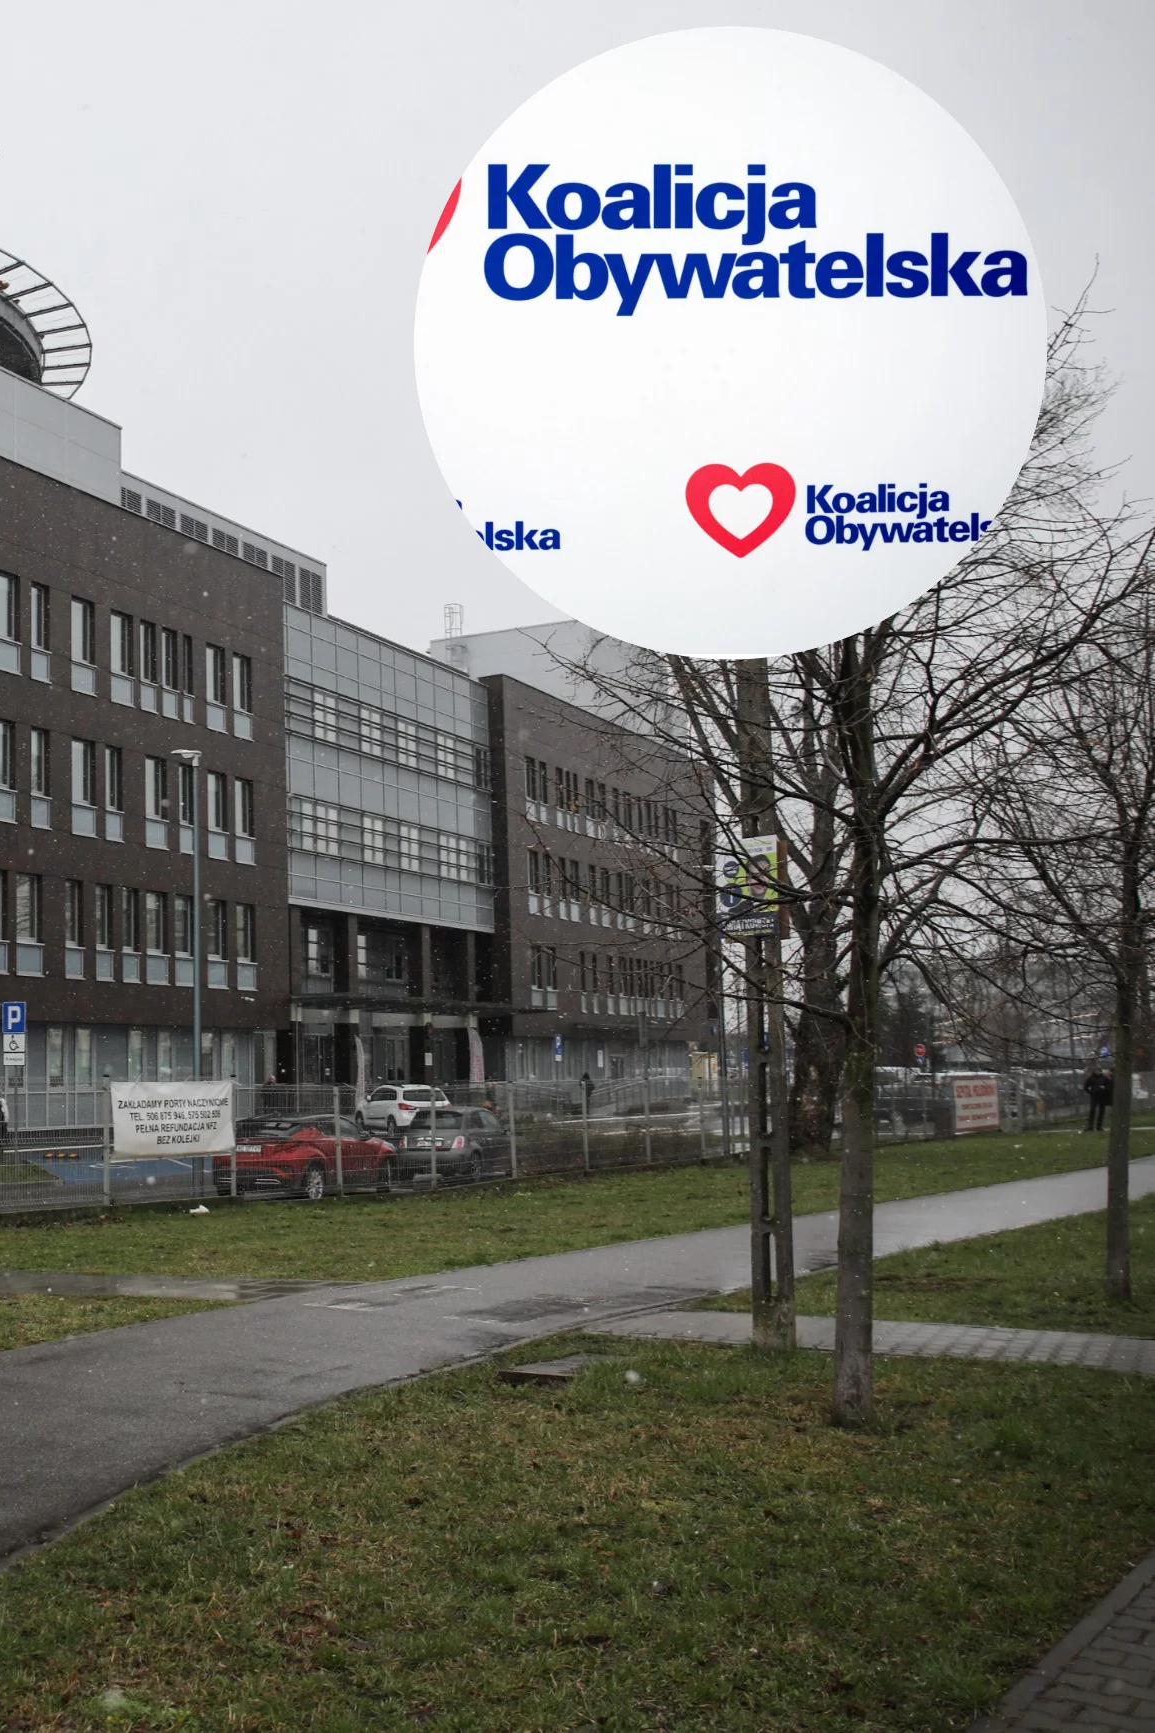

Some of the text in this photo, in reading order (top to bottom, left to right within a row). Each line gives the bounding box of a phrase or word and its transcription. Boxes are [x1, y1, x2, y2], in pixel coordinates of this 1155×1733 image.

[7, 1005, 21, 1030] P
[118, 1100, 163, 1109] ZAKŁADAMY
[164, 1099, 186, 1109] PORTY
[129, 1112, 144, 1121] TEL.
[136, 1121, 217, 1133] PEŁNA REFUNDACJA NFZ
[157, 1134, 200, 1144] BEZ KOLEJKI
